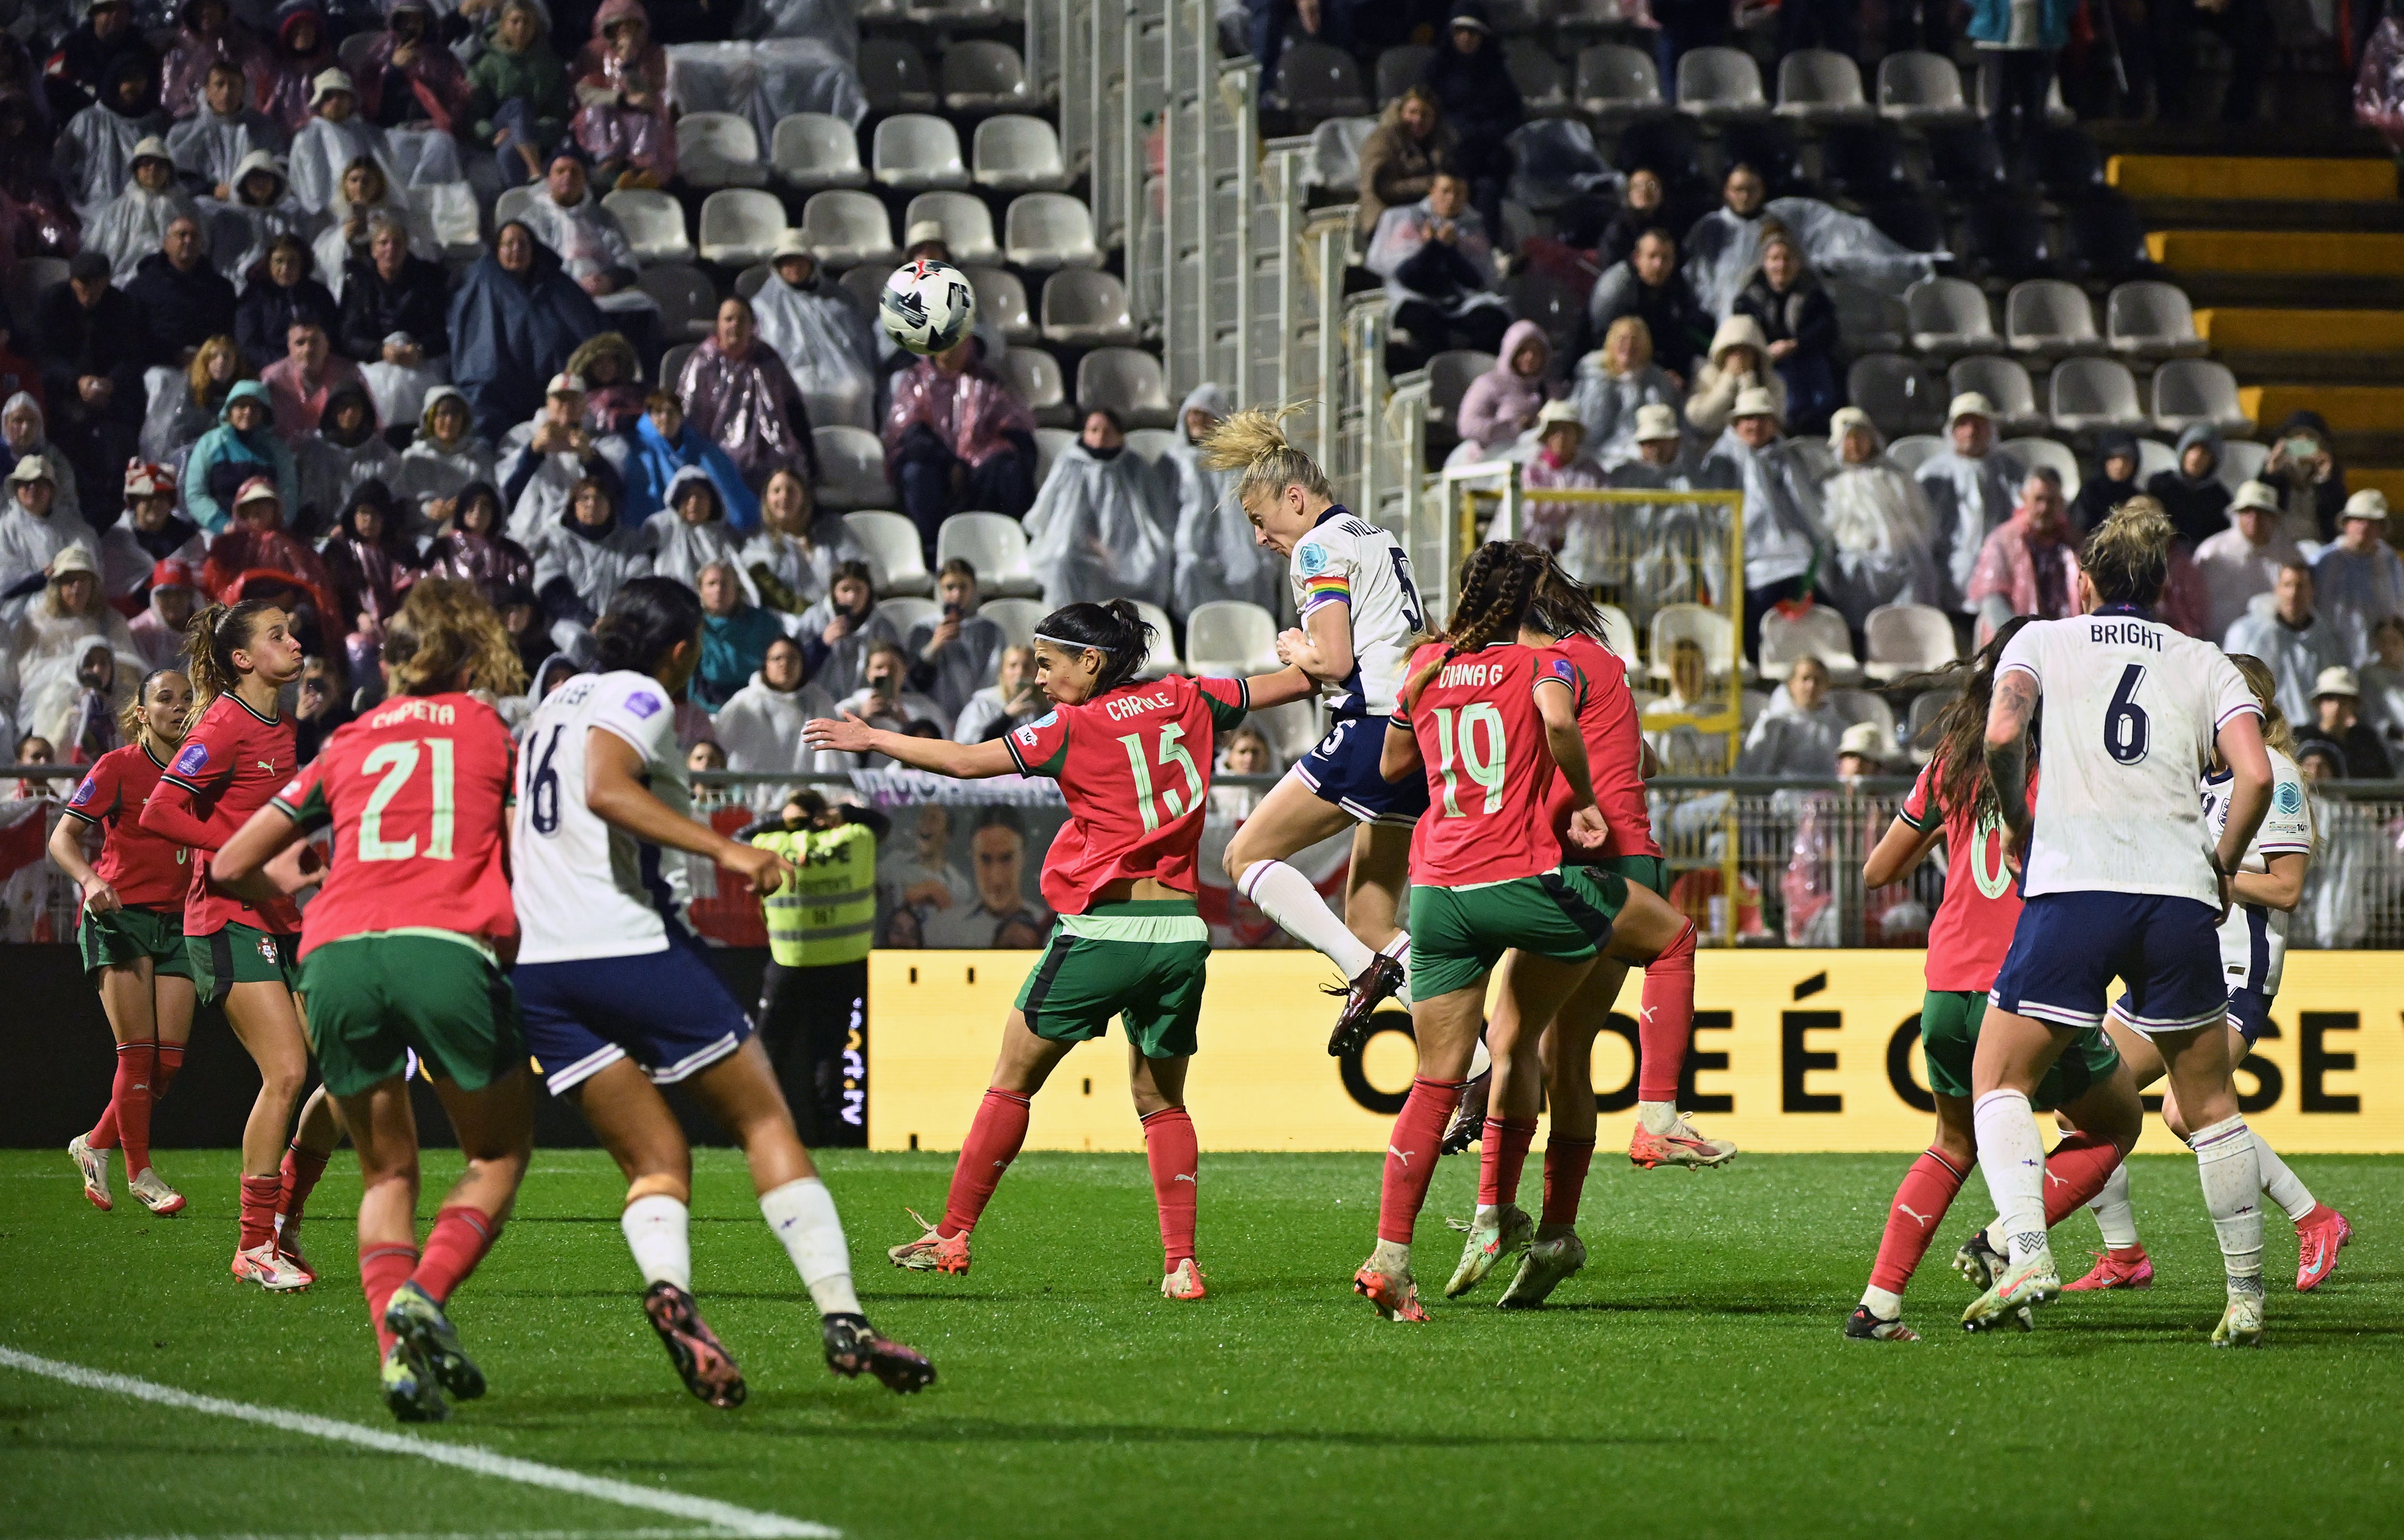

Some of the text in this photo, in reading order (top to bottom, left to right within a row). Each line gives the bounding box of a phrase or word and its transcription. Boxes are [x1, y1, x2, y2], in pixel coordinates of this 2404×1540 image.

[1388, 547, 1425, 636] 5
[2090, 623, 2164, 653] BRIGHT
[1438, 664, 1503, 689] DIANA G
[2104, 663, 2150, 766] 6
[523, 724, 564, 836] 16
[1115, 722, 1204, 837] 15
[1322, 719, 1357, 755] 5
[1430, 701, 1506, 817] 19
[358, 737, 455, 861] 21
[1340, 1009, 1734, 1115] ODE
[1781, 969, 1842, 1113] É
